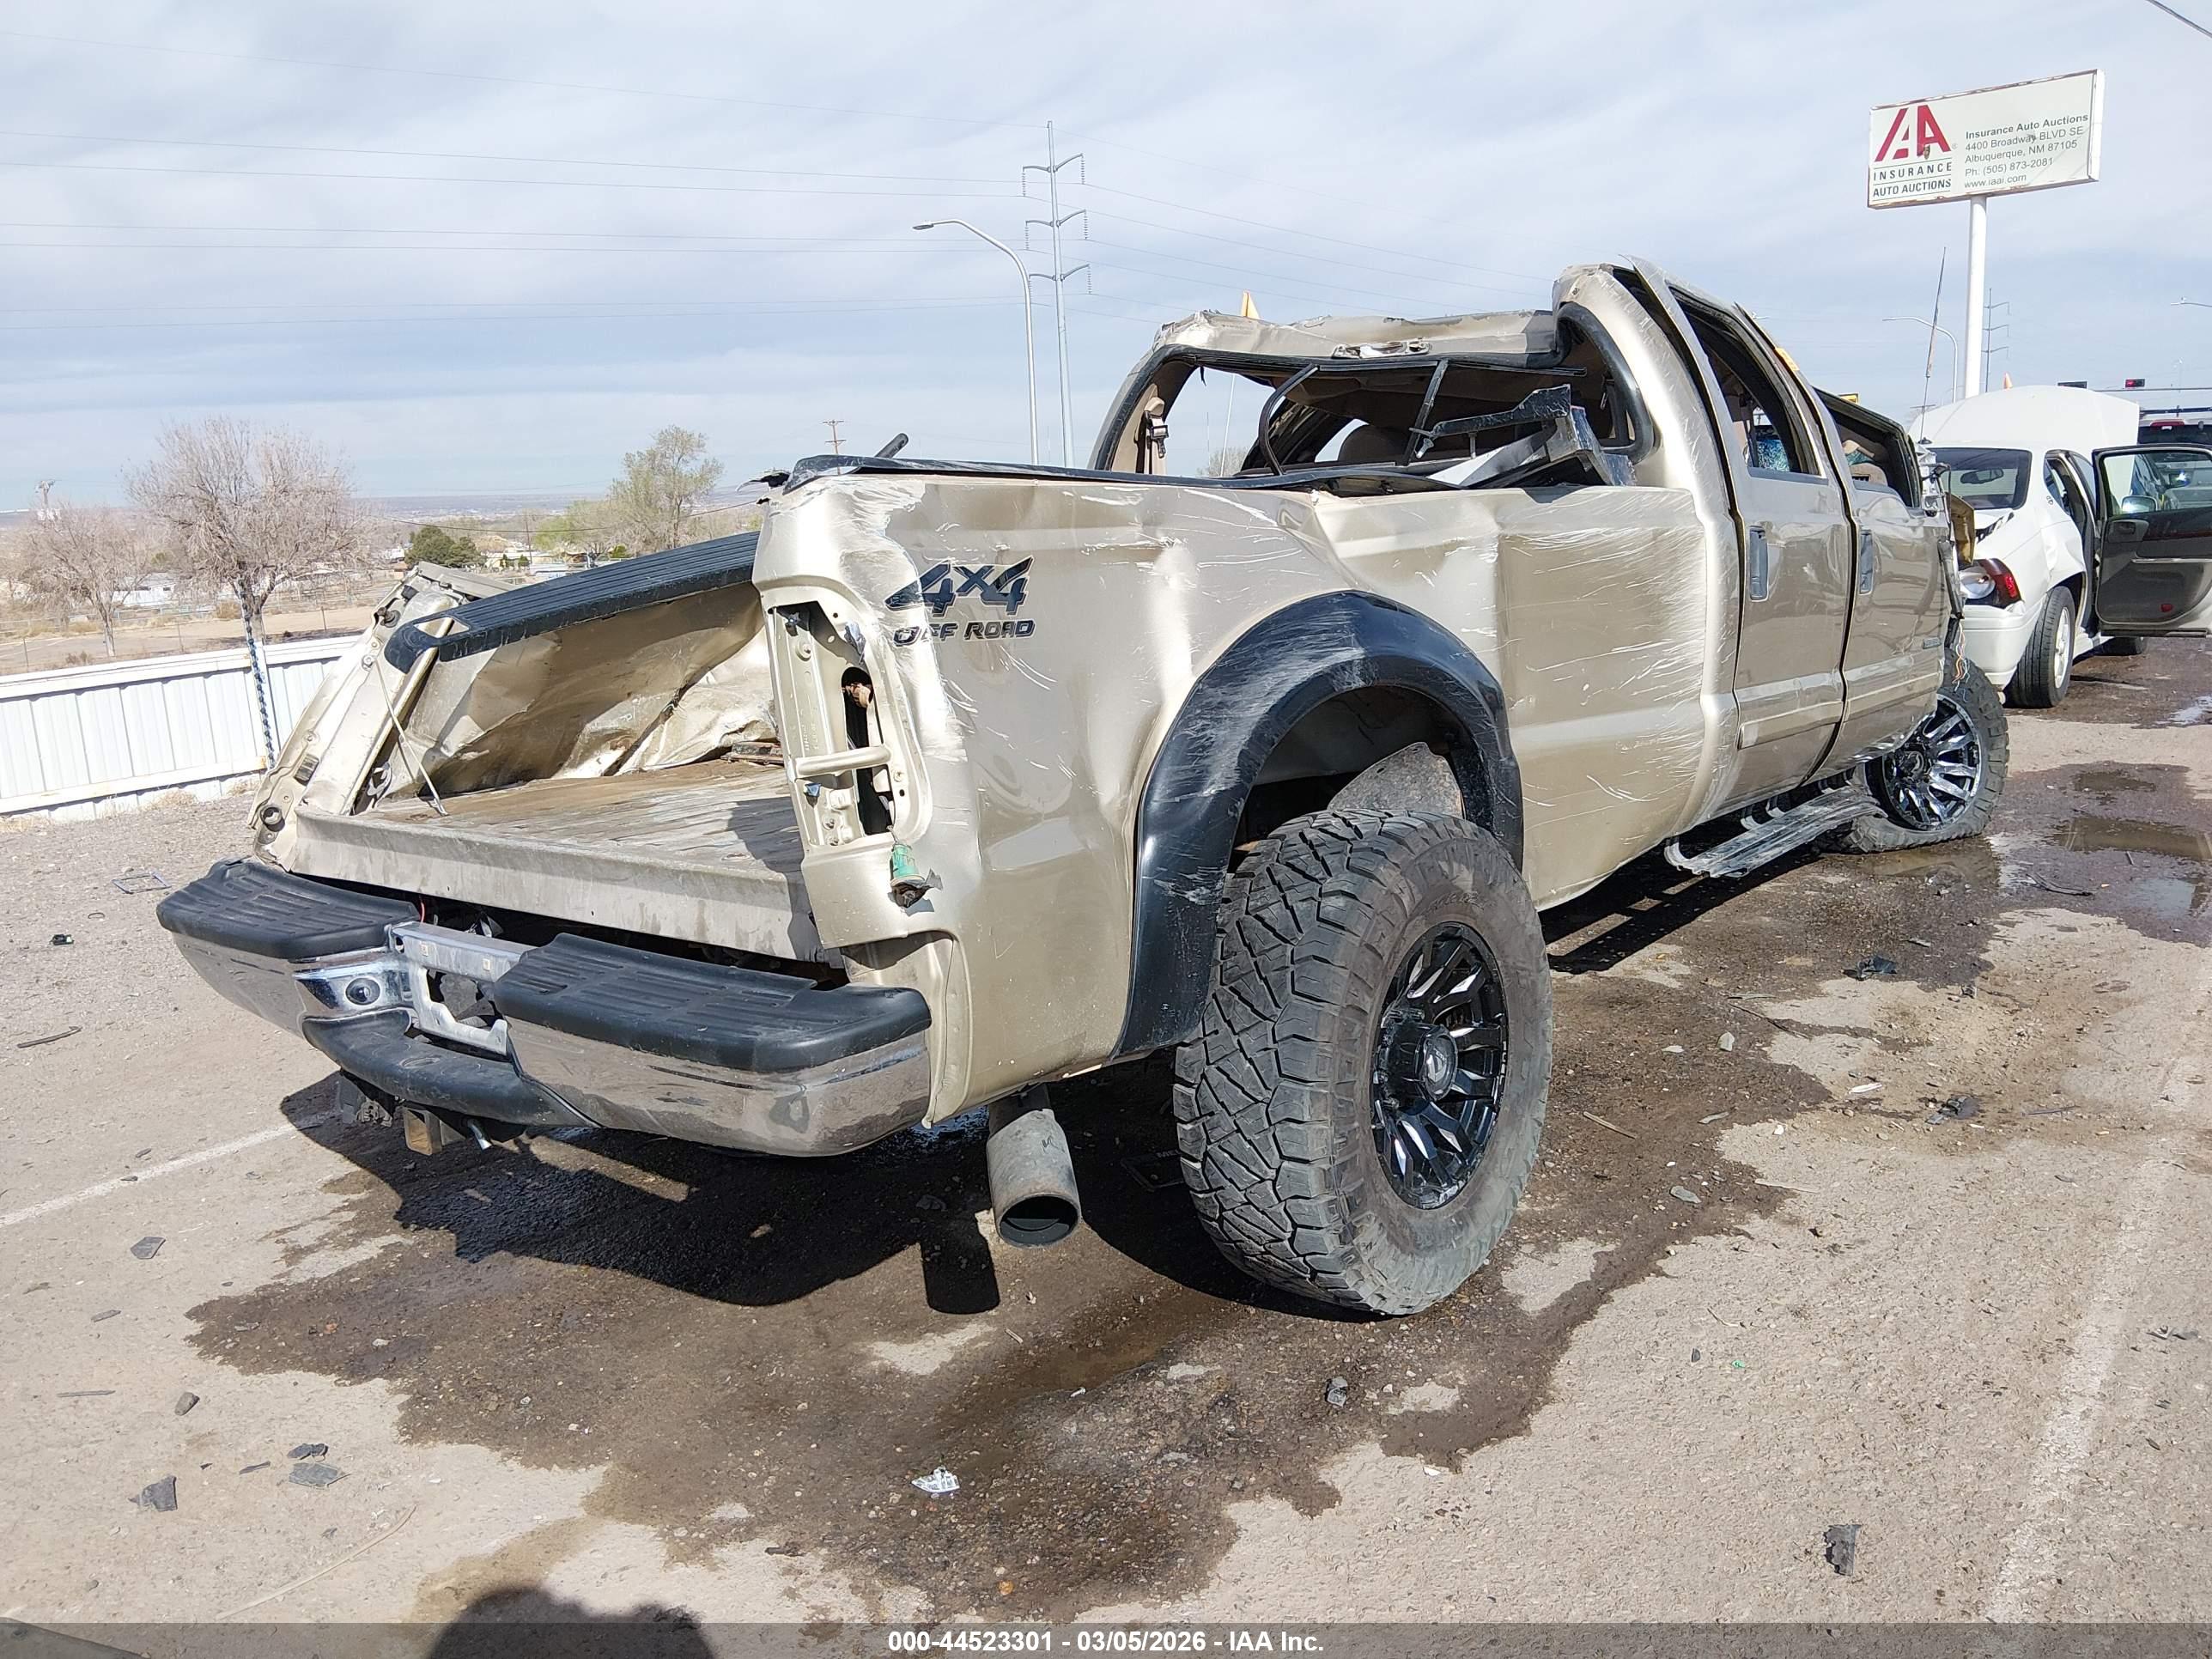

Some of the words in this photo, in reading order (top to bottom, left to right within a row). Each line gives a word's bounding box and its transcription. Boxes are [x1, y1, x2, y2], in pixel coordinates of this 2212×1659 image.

[1966, 126, 2014, 140] Insurance
[2016, 122, 2040, 132] Auto
[2043, 114, 2088, 128] Auctions
[1966, 141, 1988, 151] 4400
[1990, 133, 2037, 148] Broadway
[2039, 129, 2067, 141] BLVD
[2069, 126, 2084, 137] SE
[1965, 149, 2027, 164] Albuquerque,
[2028, 144, 2045, 155] NM
[2047, 139, 2078, 152] 87105
[1873, 161, 1952, 181] INSURANCE
[1965, 167, 1980, 177] Ph.
[1983, 163, 2007, 177] (505)
[2009, 158, 2053, 171] 873-2081
[1873, 185, 1899, 198] AUTO
[1901, 179, 1951, 194] AUCTIONS
[1964, 174, 2027, 188] www.iaai.com
[963, 619, 1036, 641] ROAD
